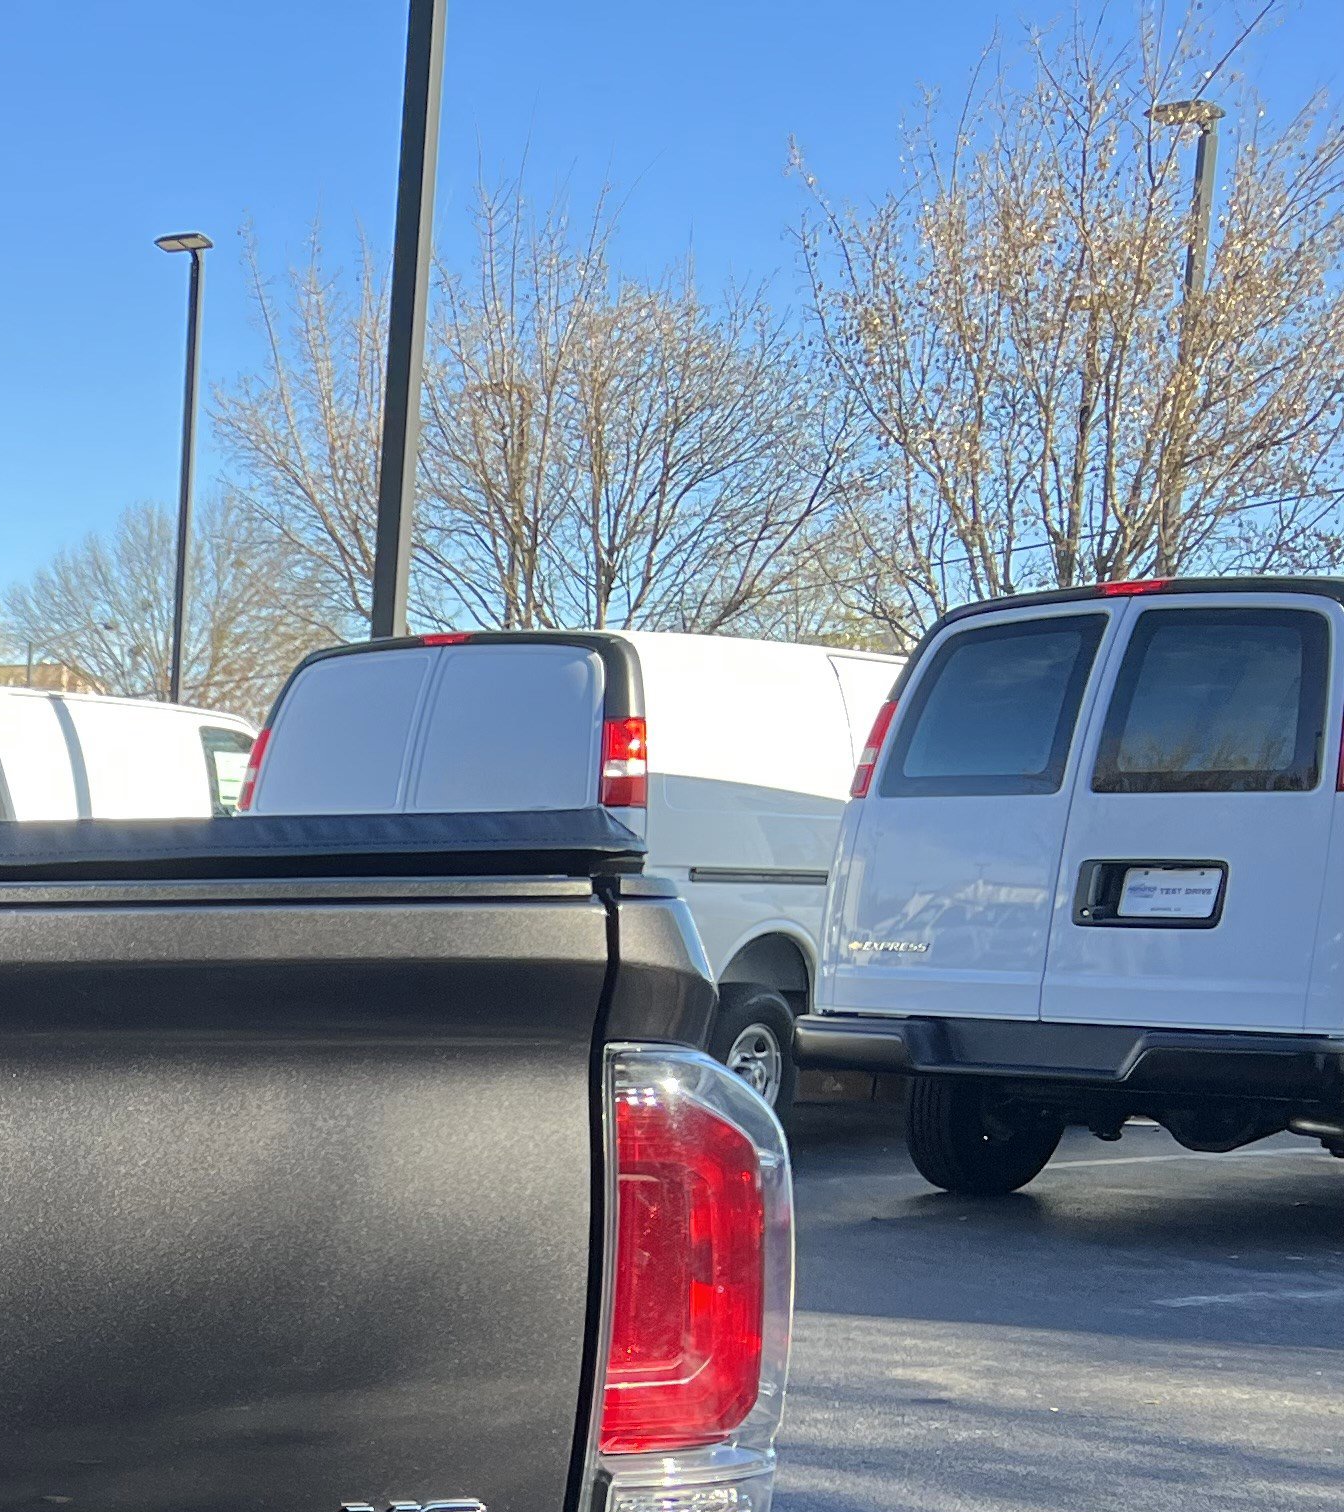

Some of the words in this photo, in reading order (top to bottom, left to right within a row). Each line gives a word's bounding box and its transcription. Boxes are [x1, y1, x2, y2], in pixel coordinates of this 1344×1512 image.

[1160, 887, 1182, 895] TEST
[1185, 887, 1213, 895] DRIVE
[863, 941, 927, 953] EXPRESS
